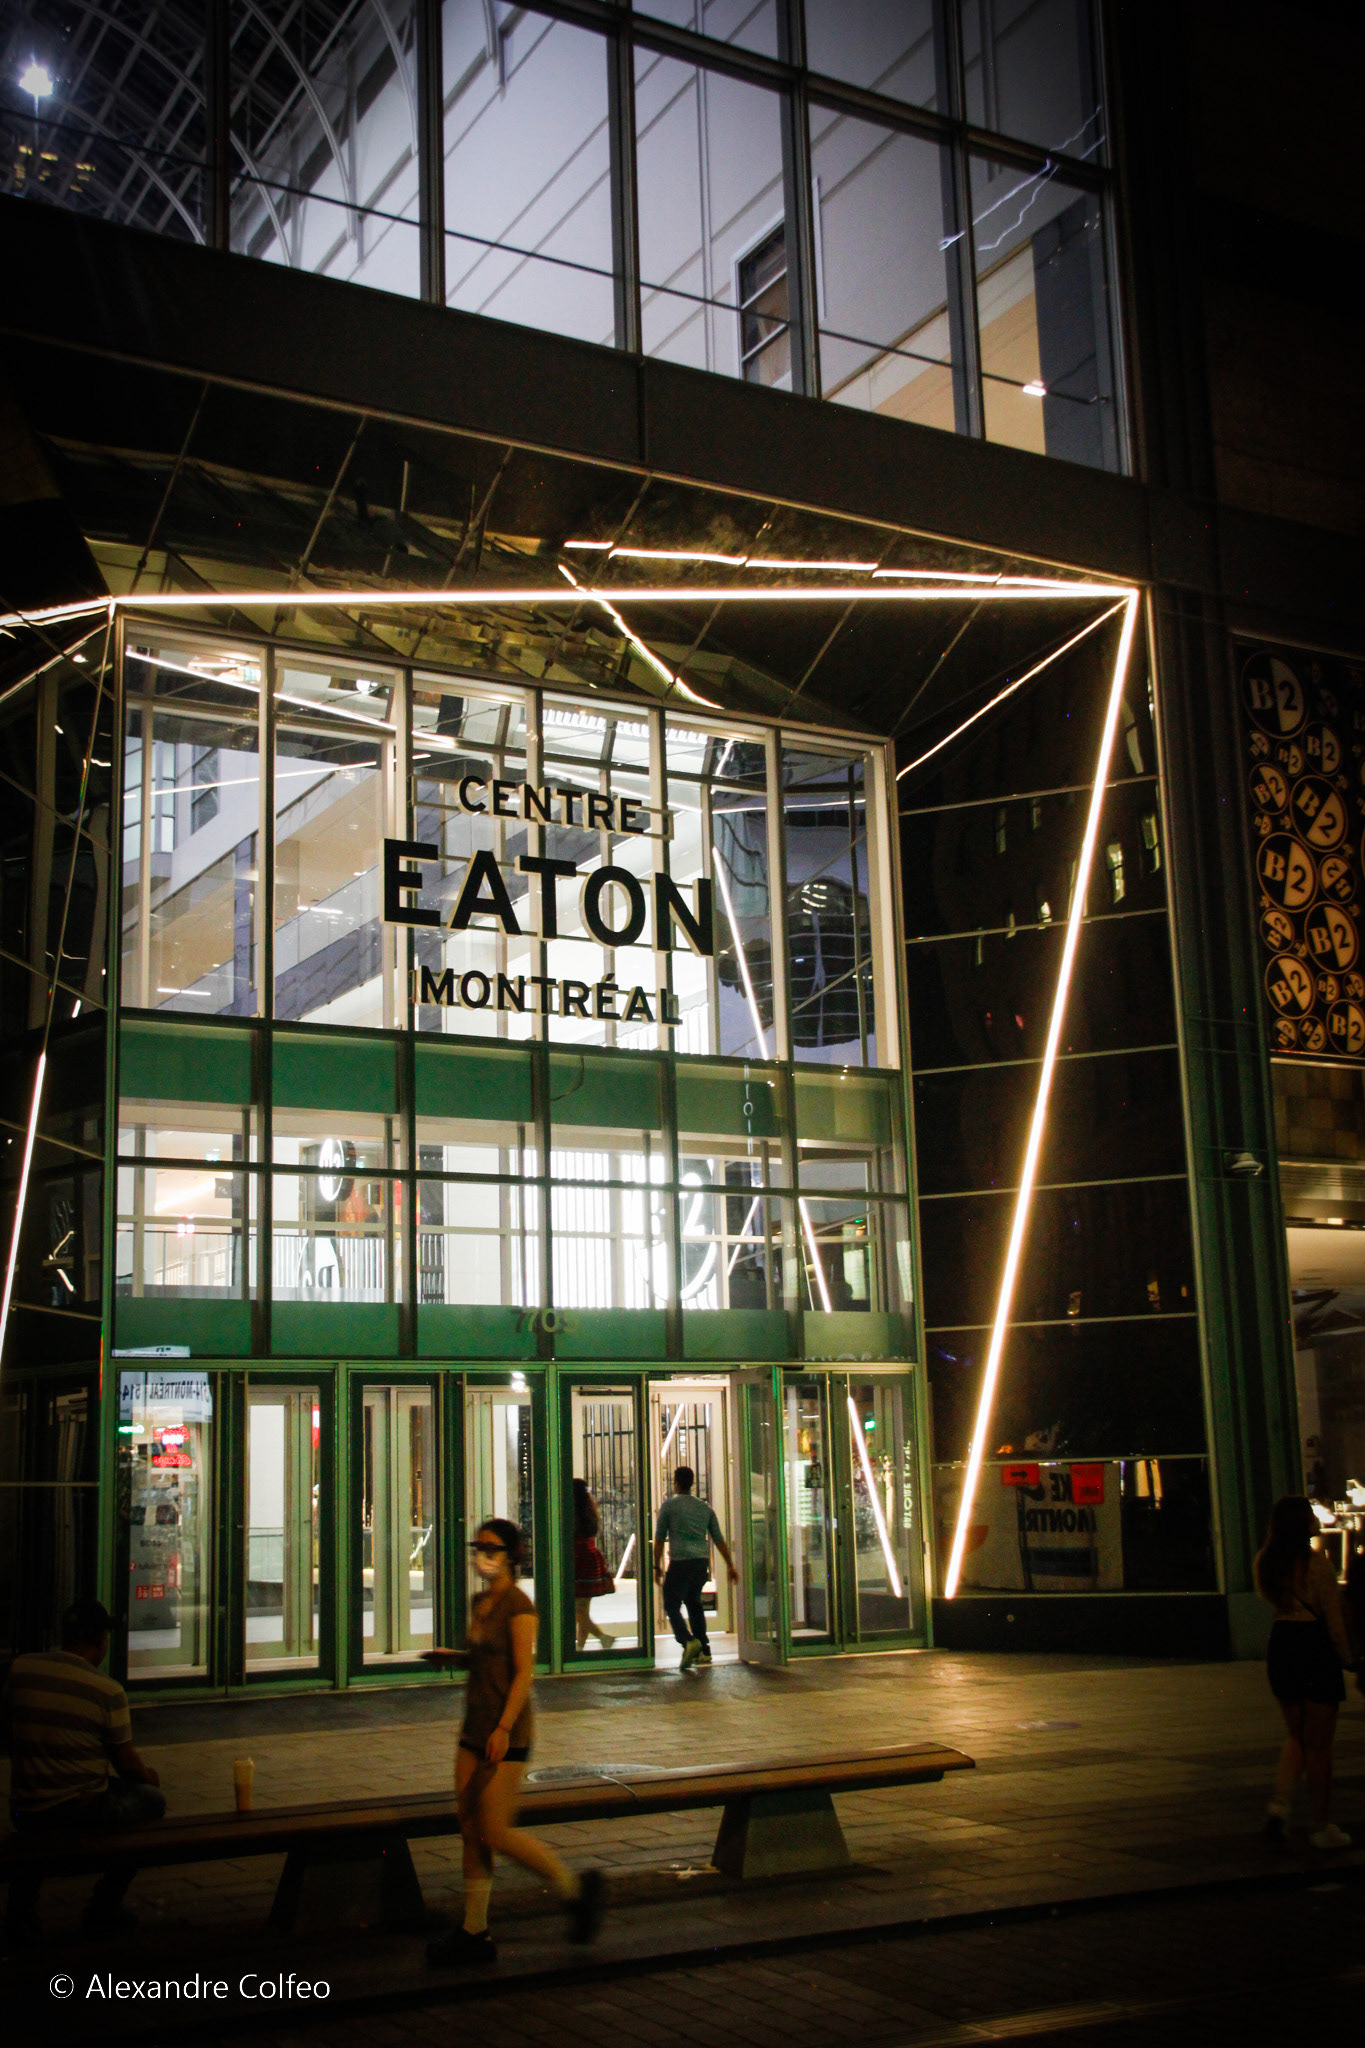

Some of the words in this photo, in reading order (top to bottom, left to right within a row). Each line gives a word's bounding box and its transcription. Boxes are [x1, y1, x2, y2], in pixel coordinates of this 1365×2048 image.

[1249, 678, 1298, 710] B2
[458, 775, 644, 834] CENTRE
[1253, 776, 1283, 805] B2
[1296, 784, 1336, 838] B2
[1262, 849, 1306, 893] B2
[383, 838, 714, 957] EATON
[1267, 917, 1286, 948] B2
[1309, 924, 1350, 955] B2
[418, 965, 682, 1026] MONTRÉAL
[1269, 971, 1307, 1008] B2
[1331, 1013, 1362, 1040] B2
